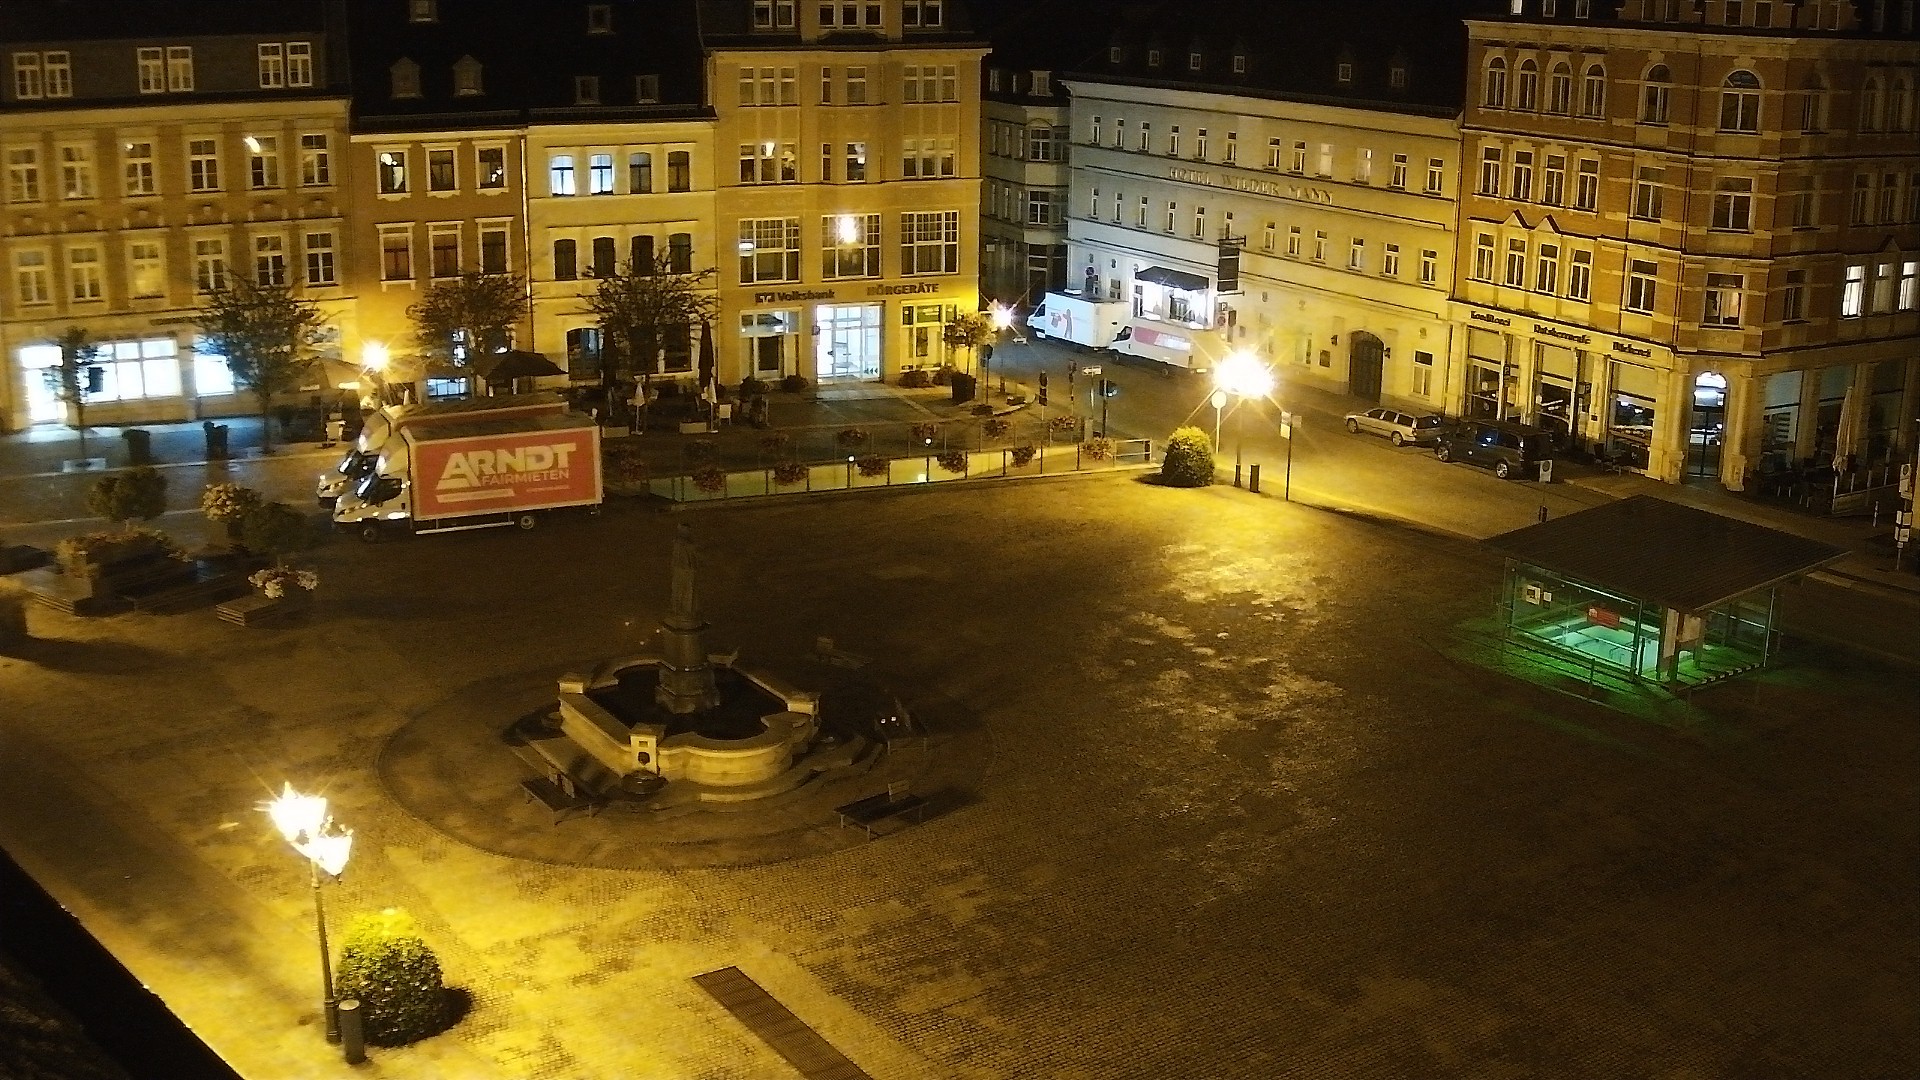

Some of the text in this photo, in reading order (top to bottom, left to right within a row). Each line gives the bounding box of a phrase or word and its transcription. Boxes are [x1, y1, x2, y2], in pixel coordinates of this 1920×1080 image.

[1170, 167, 1333, 205] HOTEL WILDER MANN
[777, 289, 835, 301] Volksbank
[867, 282, 939, 296] HÖRGERÄTE
[436, 443, 576, 490] ARNDT
[481, 469, 569, 486] FAIRMIETEN
